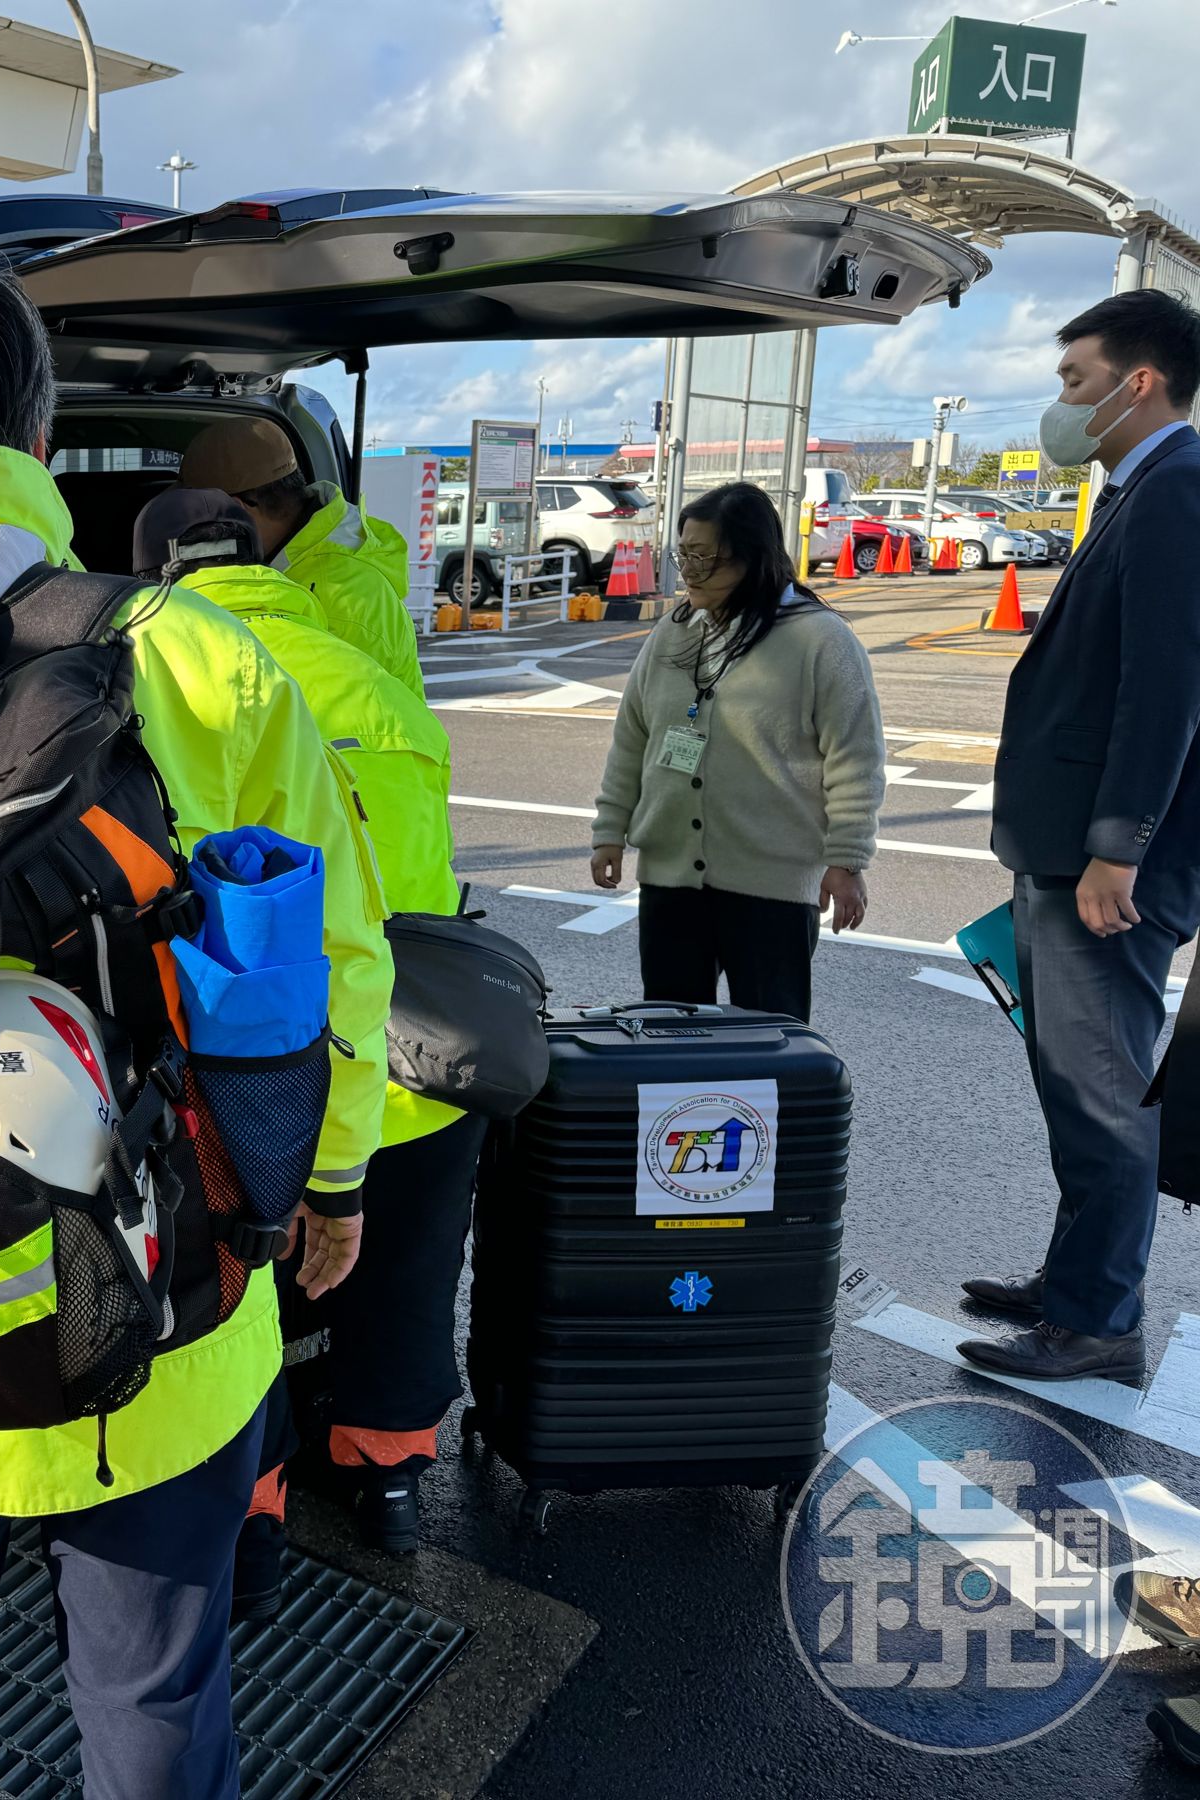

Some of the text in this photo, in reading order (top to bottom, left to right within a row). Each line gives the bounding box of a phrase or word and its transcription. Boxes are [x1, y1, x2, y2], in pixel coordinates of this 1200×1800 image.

[914, 55, 940, 127] 入口
[978, 44, 1056, 103] 入口
[1007, 453, 1034, 464] 出口
[418, 462, 437, 569] KIRIN
[840, 1269, 868, 1293] KMQ
